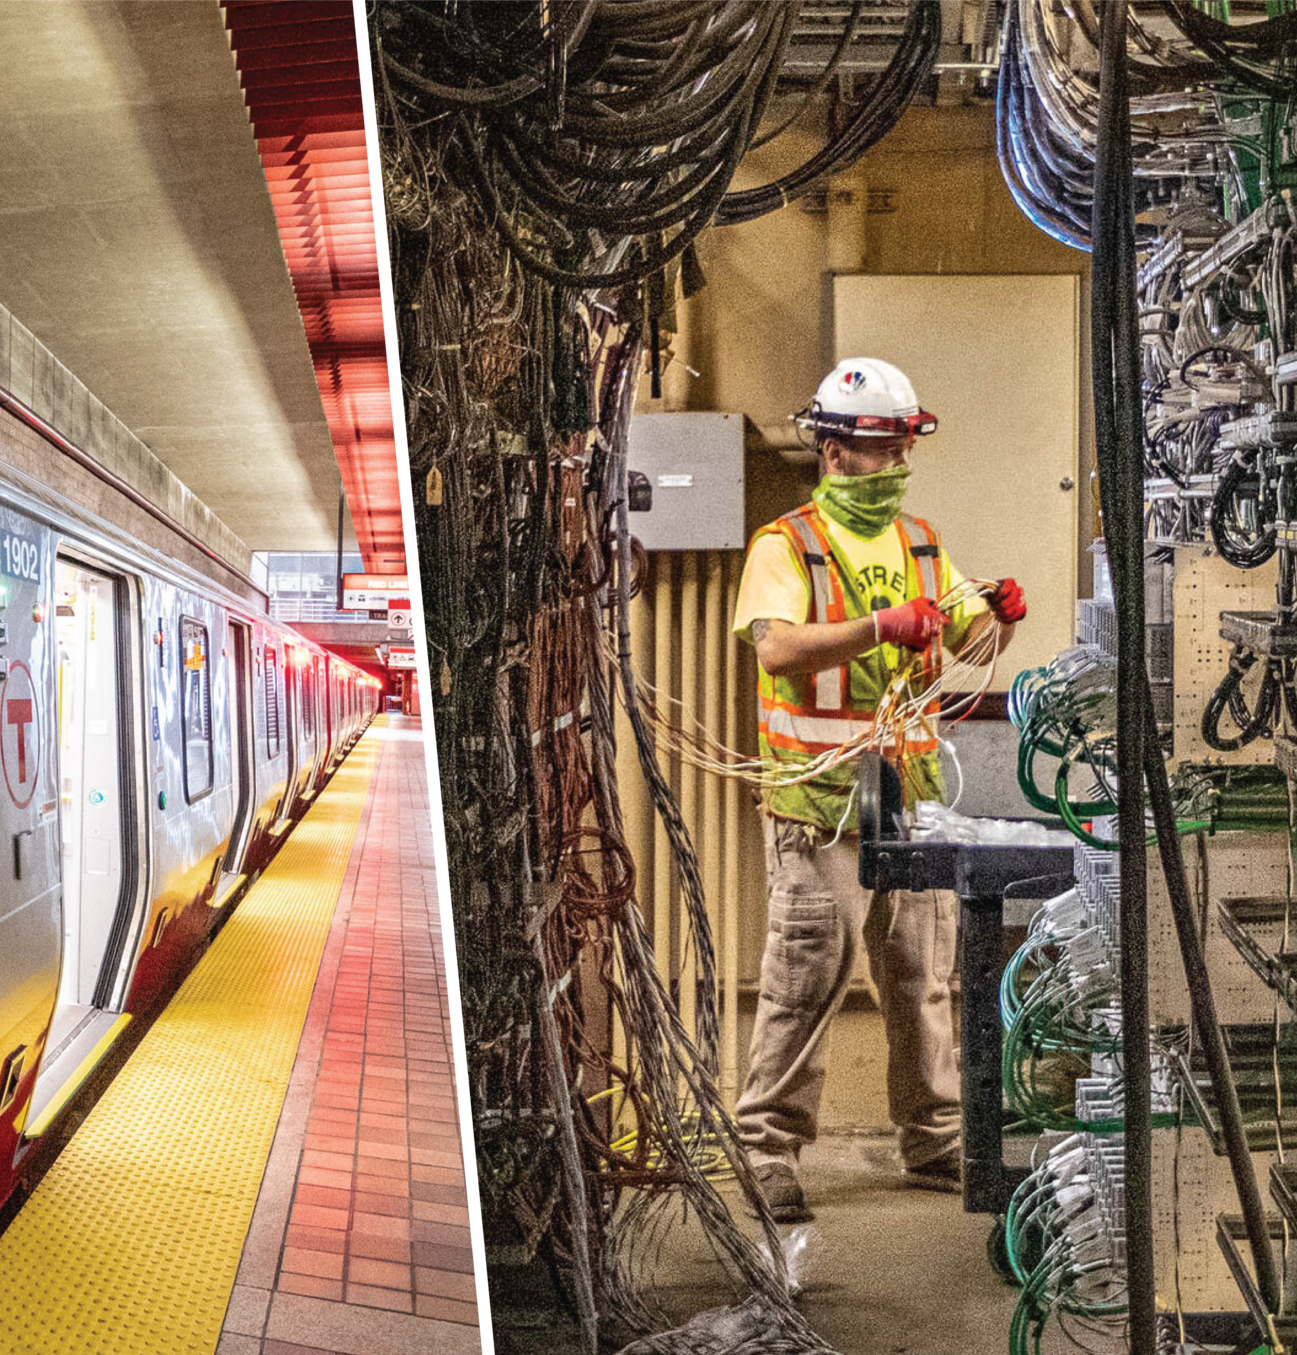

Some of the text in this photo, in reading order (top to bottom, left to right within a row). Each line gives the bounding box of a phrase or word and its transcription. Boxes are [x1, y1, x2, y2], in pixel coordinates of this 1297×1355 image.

[4, 534, 39, 581] 1902
[855, 565, 905, 594] STRE
[7, 698, 33, 784] T
